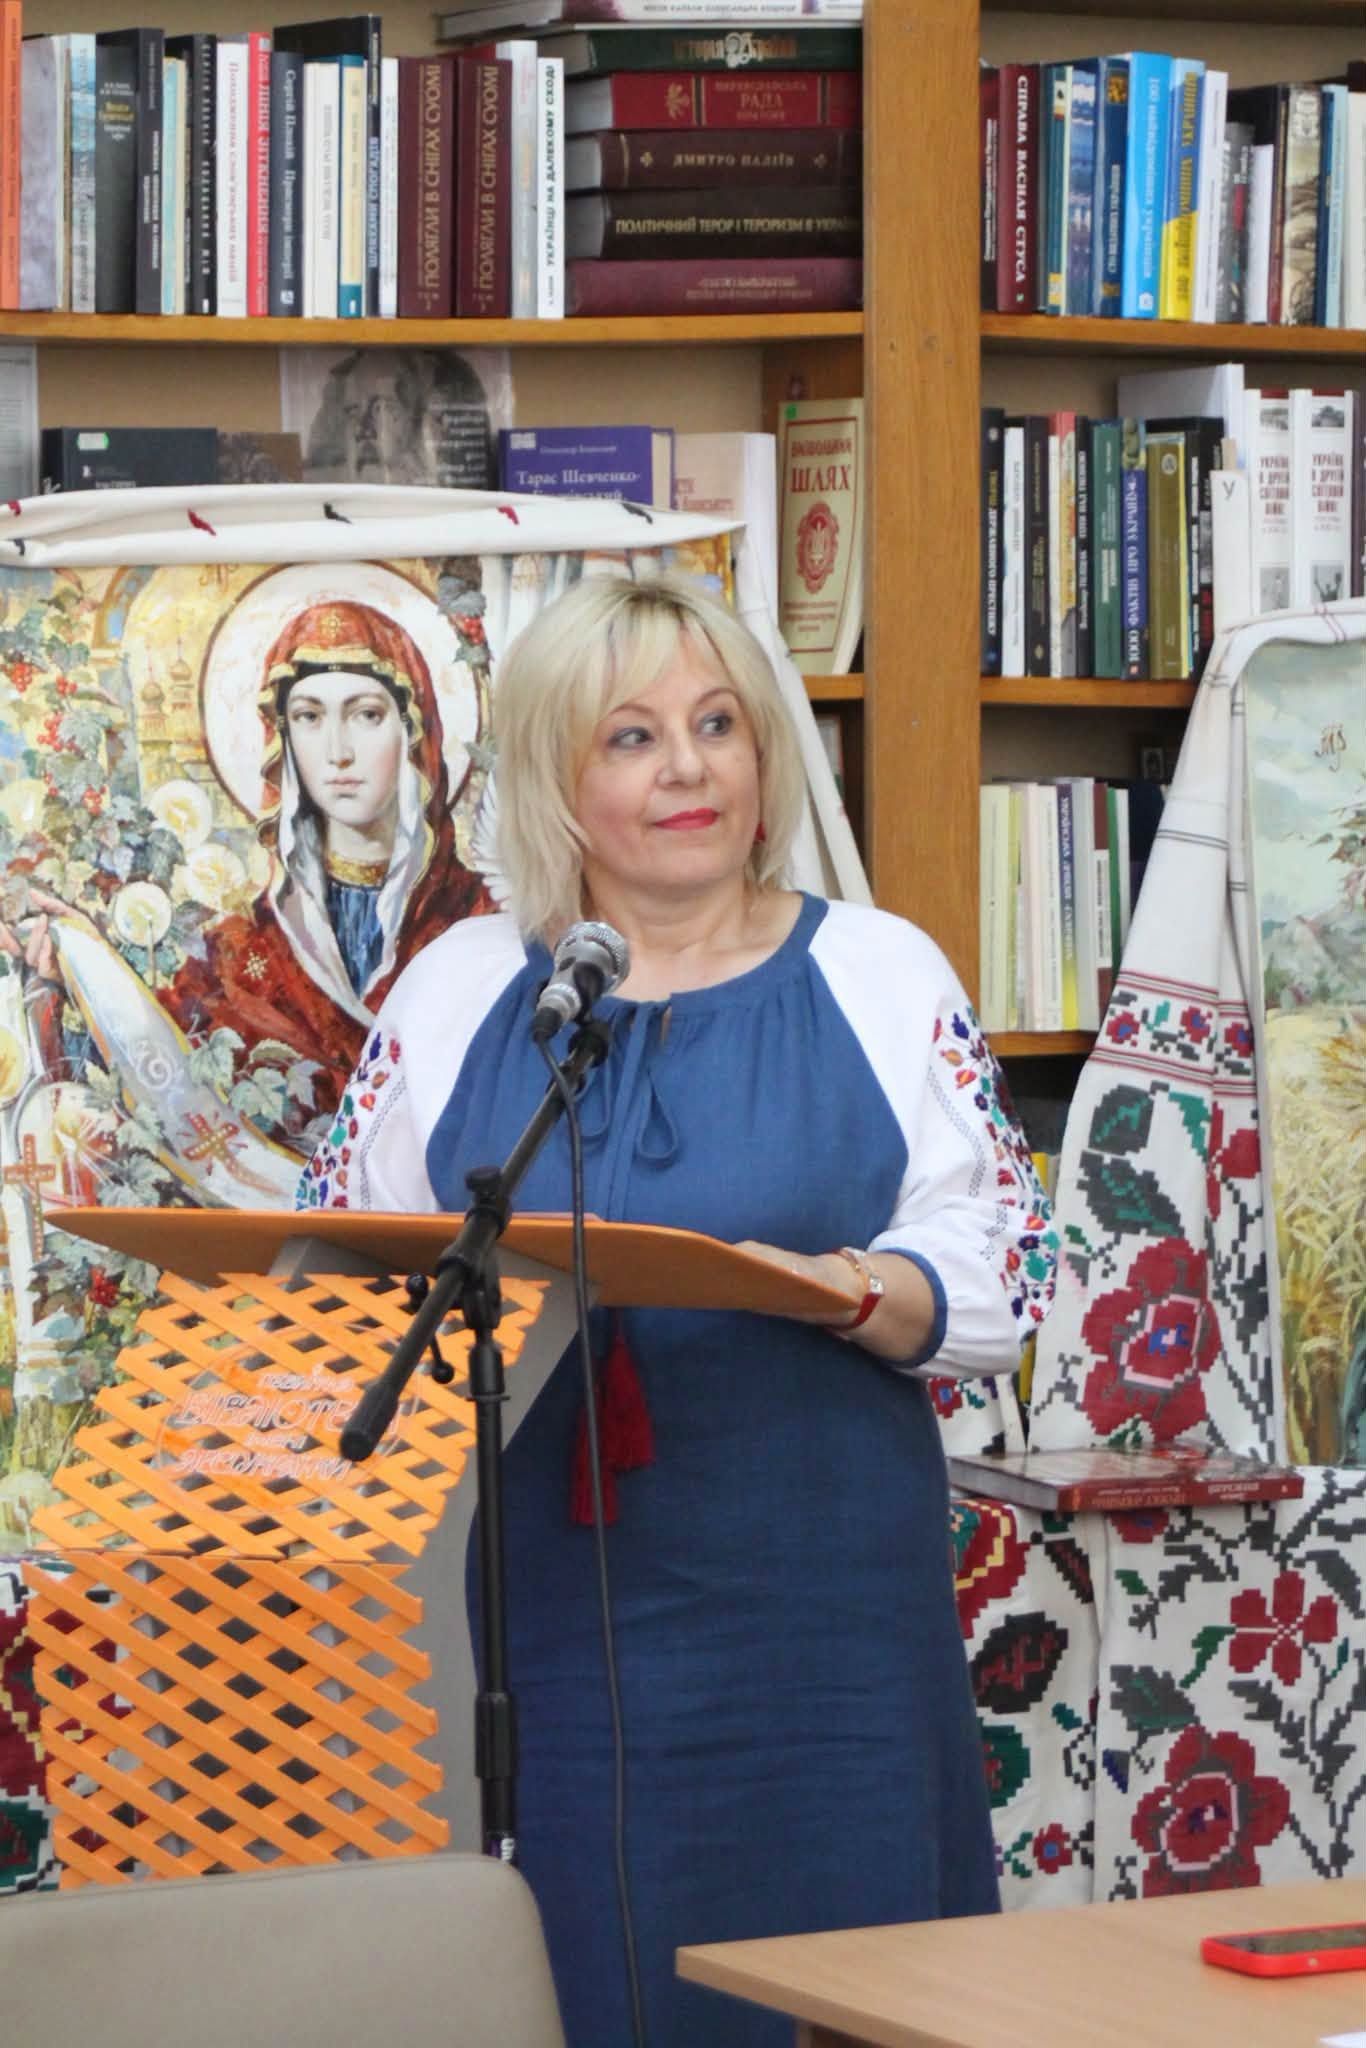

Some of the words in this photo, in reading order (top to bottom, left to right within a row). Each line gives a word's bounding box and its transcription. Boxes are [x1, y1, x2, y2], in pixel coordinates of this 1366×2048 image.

[424, 64, 441, 123] СУОМІ
[482, 65, 499, 125] СУОМІ
[544, 65, 555, 105] СХОДІ
[740, 93, 784, 109] РАДА
[1016, 75, 1029, 144] СПРАВА
[424, 128, 441, 188] СНІГАХ
[480, 129, 497, 189] СНІГАХ
[544, 110, 555, 182] ДАЛЕКОМУ
[673, 153, 736, 168] ДМИТРО
[424, 192, 440, 203] В
[480, 192, 496, 204] В
[545, 185, 554, 202] НА
[1016, 149, 1028, 220] ВАСИЛЯ
[424, 207, 441, 288] ПОЛЯГЛИ
[479, 208, 495, 290] ПОЛЯГЛИ
[543, 207, 555, 266] УКРАЇНЦІ
[615, 217, 697, 235] ПОЛІТИЧНИЙ
[699, 219, 735, 234] ТЕРОР
[743, 218, 804, 233] ТЕРОРИЗМ
[1015, 225, 1028, 283] СТУСА
[516, 470, 559, 488] Тарас
[562, 468, 641, 485] Шевченко-
[791, 464, 851, 493] ШЛЯХ
[987, 508, 998, 578] ДЕРЖАВНОГО
[1126, 546, 1138, 573] ПРО
[1126, 577, 1139, 626] ФАКТІВ
[1127, 630, 1140, 662] 1000
